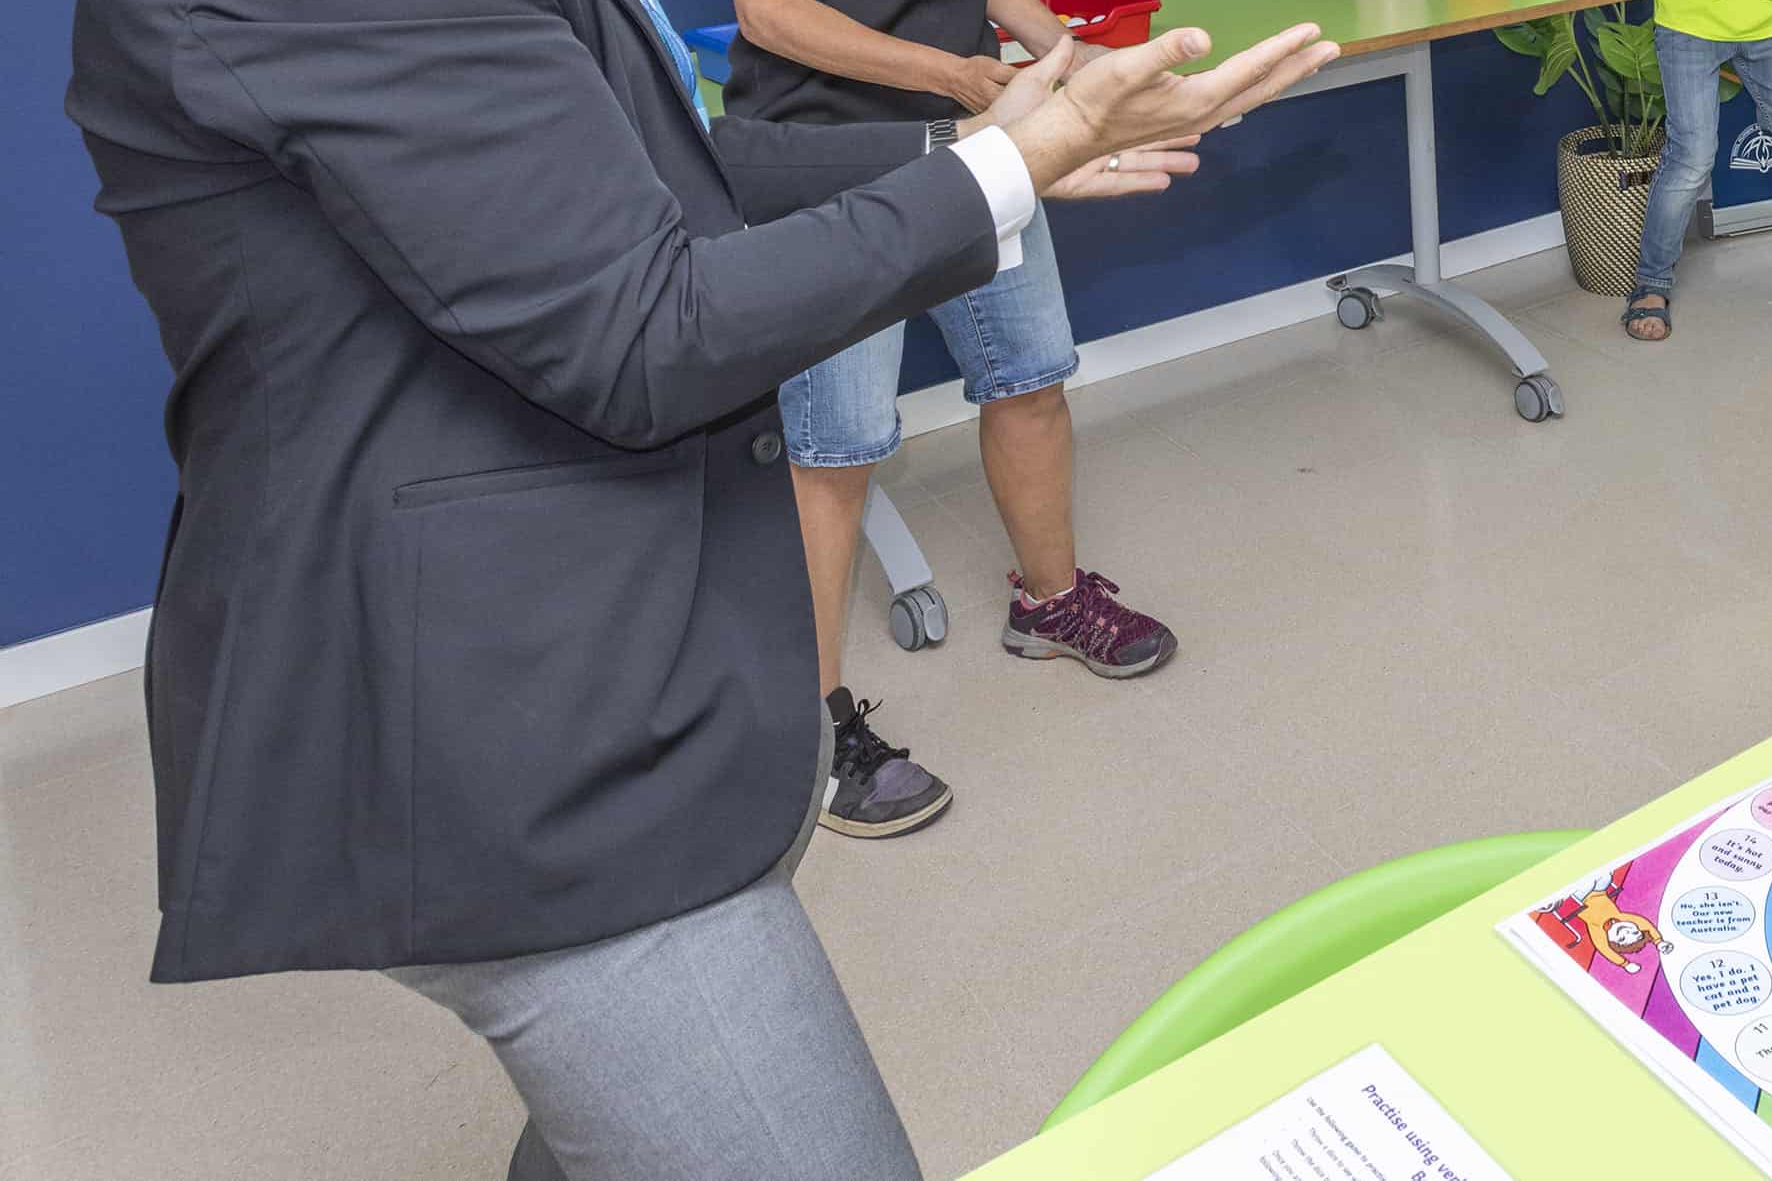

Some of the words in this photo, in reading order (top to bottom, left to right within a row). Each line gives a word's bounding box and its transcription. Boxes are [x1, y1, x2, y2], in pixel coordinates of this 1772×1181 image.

[1710, 959, 1724, 968] 12
[1360, 1083, 1408, 1133] Practise
[1405, 1129, 1440, 1167] using
